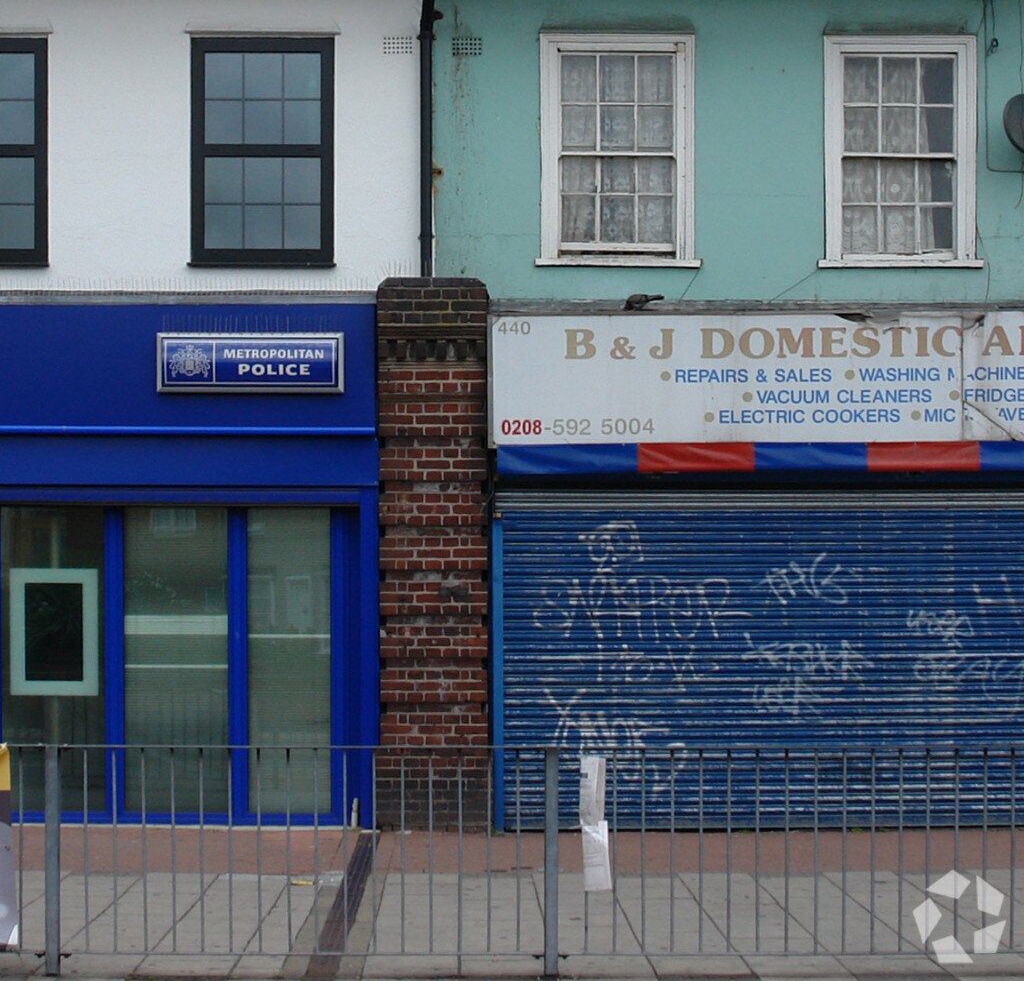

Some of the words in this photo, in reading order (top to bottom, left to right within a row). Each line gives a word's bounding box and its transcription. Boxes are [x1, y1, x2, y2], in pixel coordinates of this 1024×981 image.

[498, 321, 531, 335] 440
[564, 328, 597, 360] B
[609, 336, 637, 360] &
[649, 328, 675, 360] J
[699, 326, 963, 360] DOMESTIC
[223, 348, 325, 360] METROPOLITAN
[237, 363, 311, 376] POLICE
[675, 368, 749, 383] REPAIRS
[755, 368, 768, 383] &
[774, 368, 833, 383] SALES
[858, 367, 941, 382] WASHING
[756, 389, 830, 404] VACUUM
[836, 389, 933, 404] CLEANERS
[964, 387, 1024, 403] FRIDGE
[718, 409, 806, 424] ELECTRIC
[811, 408, 901, 423] COOKERS
[501, 419, 591, 436] 0208-592
[600, 418, 656, 436] 5004
